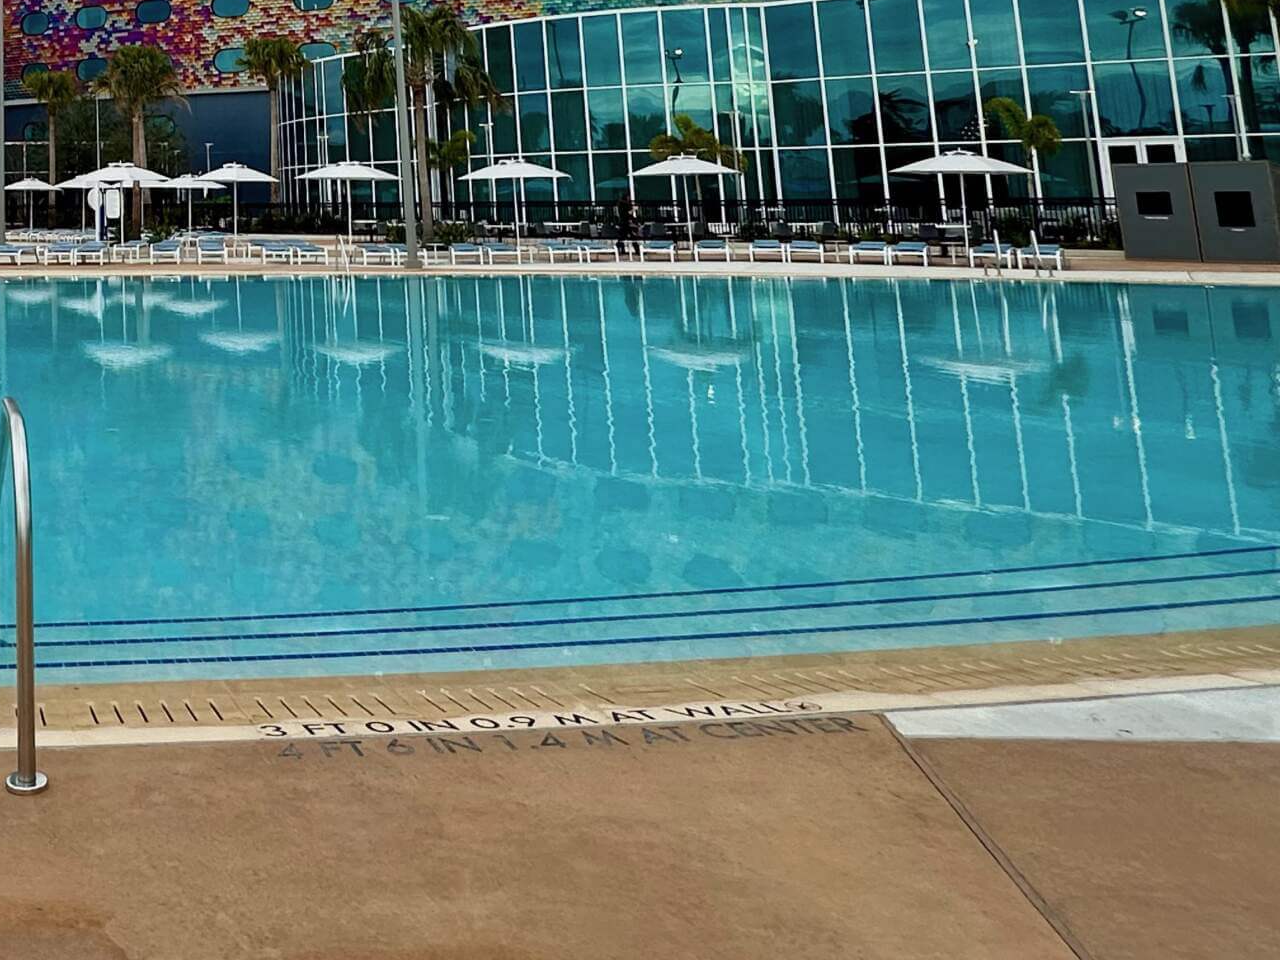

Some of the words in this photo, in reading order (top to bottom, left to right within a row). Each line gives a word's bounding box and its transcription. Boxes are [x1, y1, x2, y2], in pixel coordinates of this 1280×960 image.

[260, 725, 287, 737] 3
[302, 723, 346, 735] FT
[407, 719, 461, 732] IN
[470, 716, 536, 728] 0.9
[553, 713, 599, 726] M
[611, 709, 656, 722] AT
[665, 703, 792, 717] WALL
[278, 742, 304, 759] 4
[319, 740, 365, 758] FT
[386, 738, 416, 755] 6
[426, 737, 483, 754] IN
[581, 729, 631, 746] M
[641, 726, 692, 744] AT
[699, 716, 870, 740] CENTER
